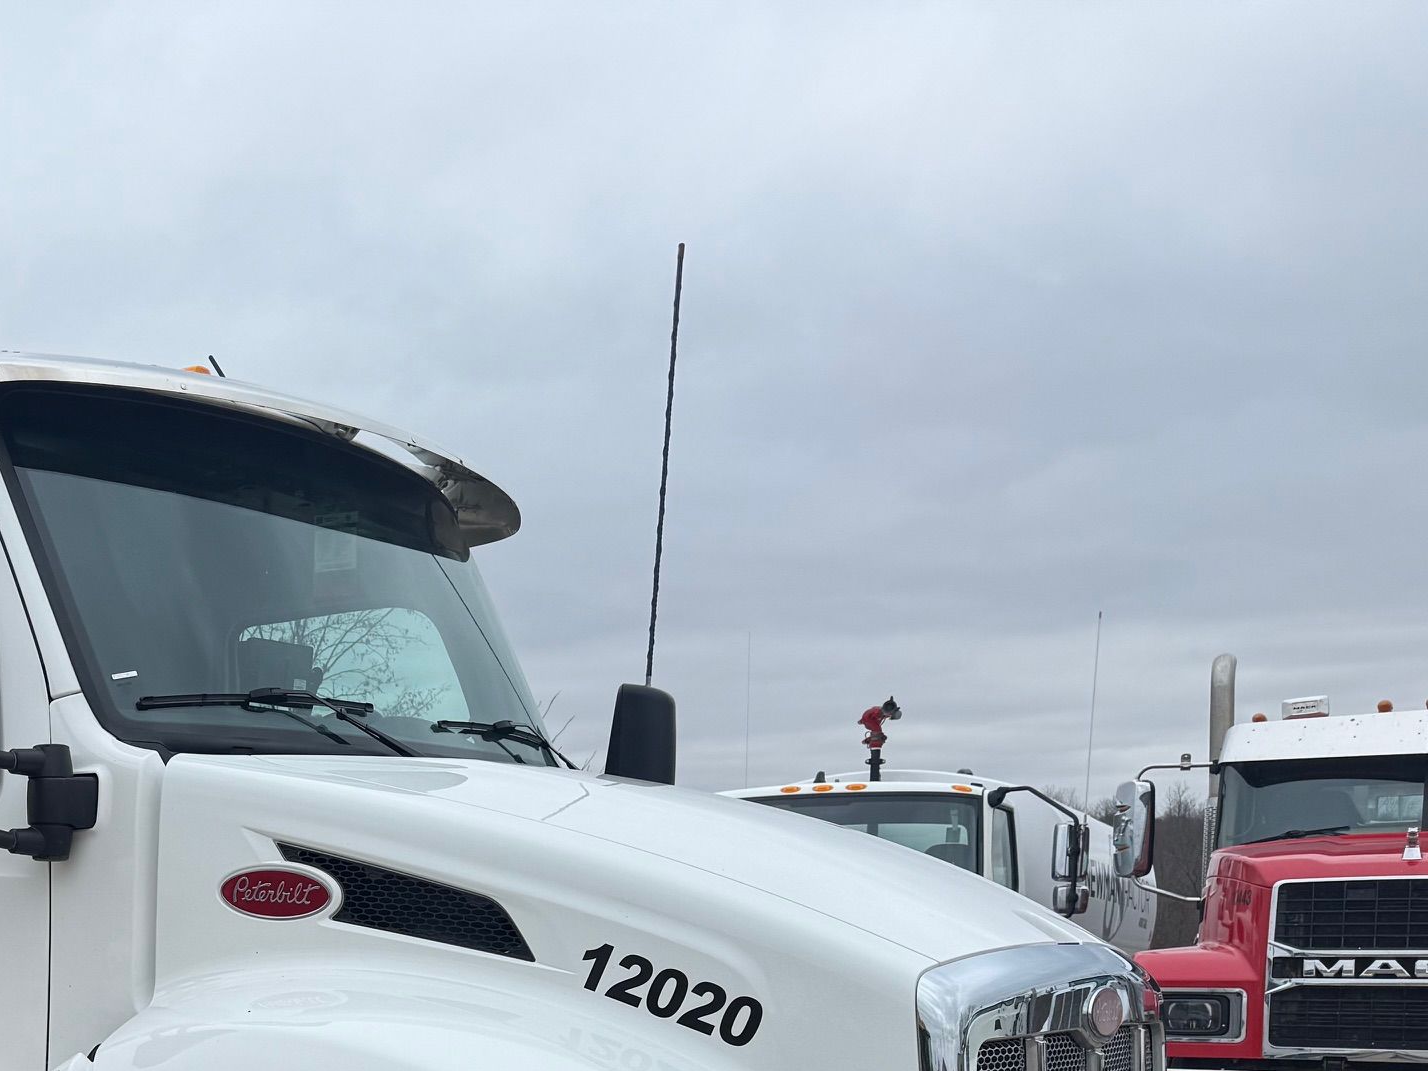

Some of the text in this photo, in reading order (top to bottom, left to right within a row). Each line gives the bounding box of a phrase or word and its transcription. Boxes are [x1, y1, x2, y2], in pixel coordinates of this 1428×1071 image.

[233, 876, 320, 904] Peterbilt
[1303, 959, 1428, 977] MA
[582, 943, 763, 1047] 12020
